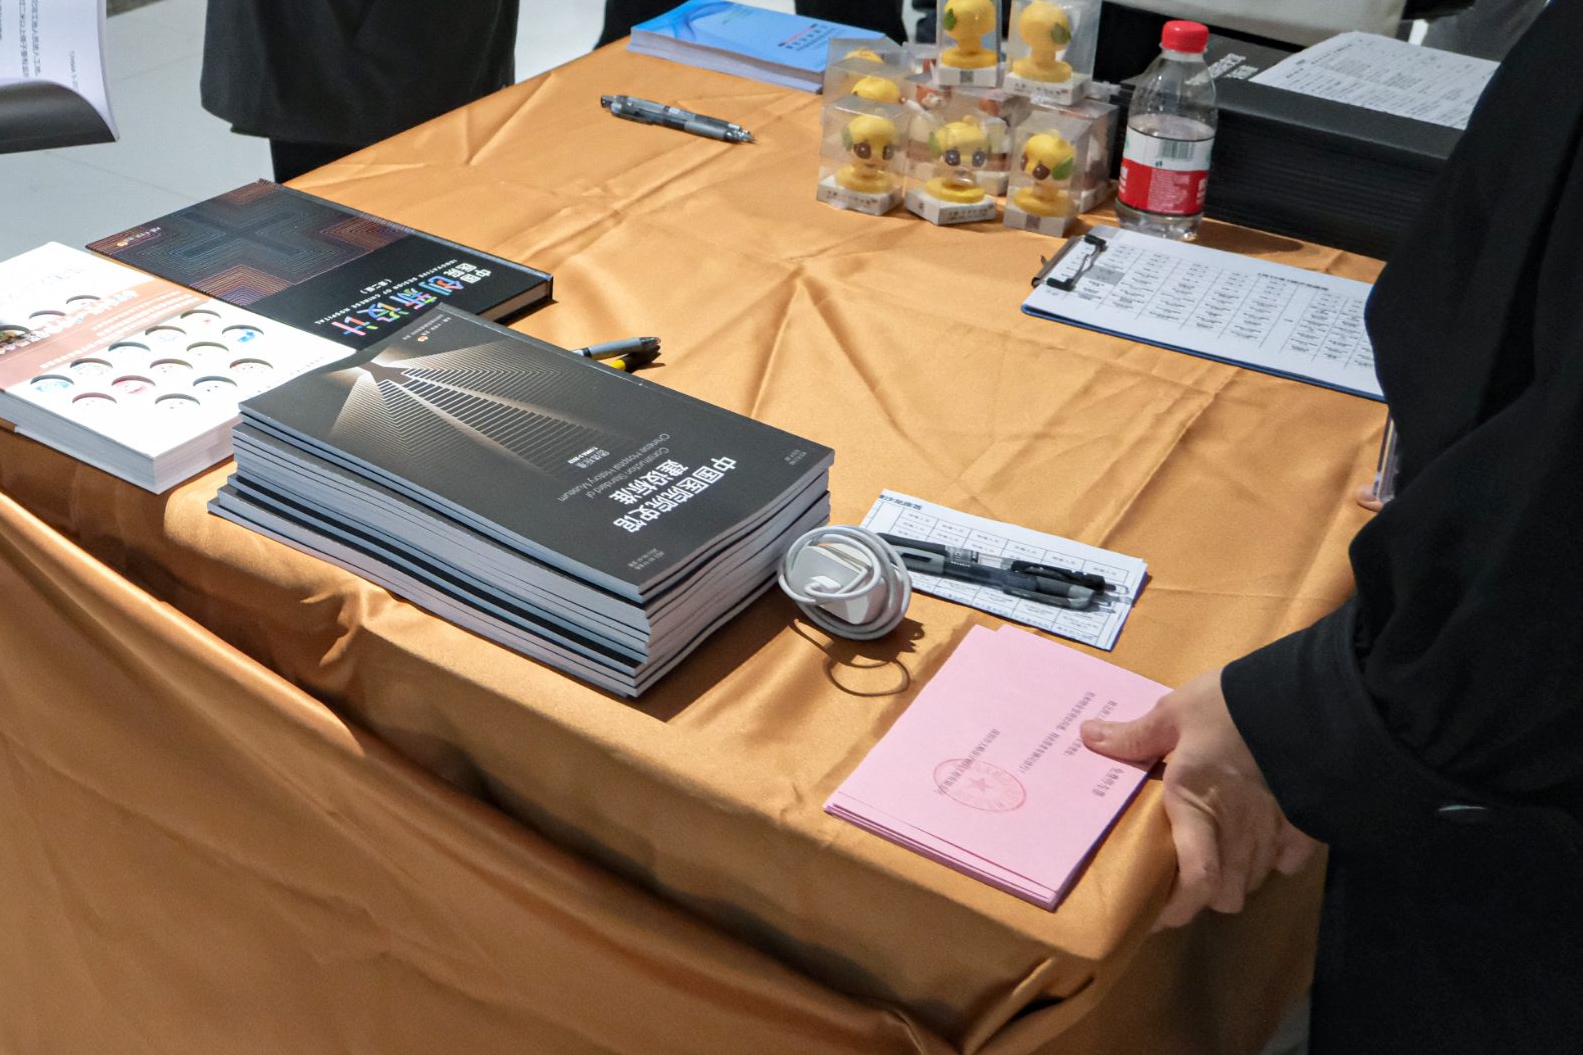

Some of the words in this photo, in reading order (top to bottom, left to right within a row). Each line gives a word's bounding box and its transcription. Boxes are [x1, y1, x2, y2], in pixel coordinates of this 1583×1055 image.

[331, 275, 465, 336] 创新设计
[608, 459, 688, 507] 建设标准
[619, 444, 671, 476] Construction
[611, 455, 737, 534] 中国医院院史馆
